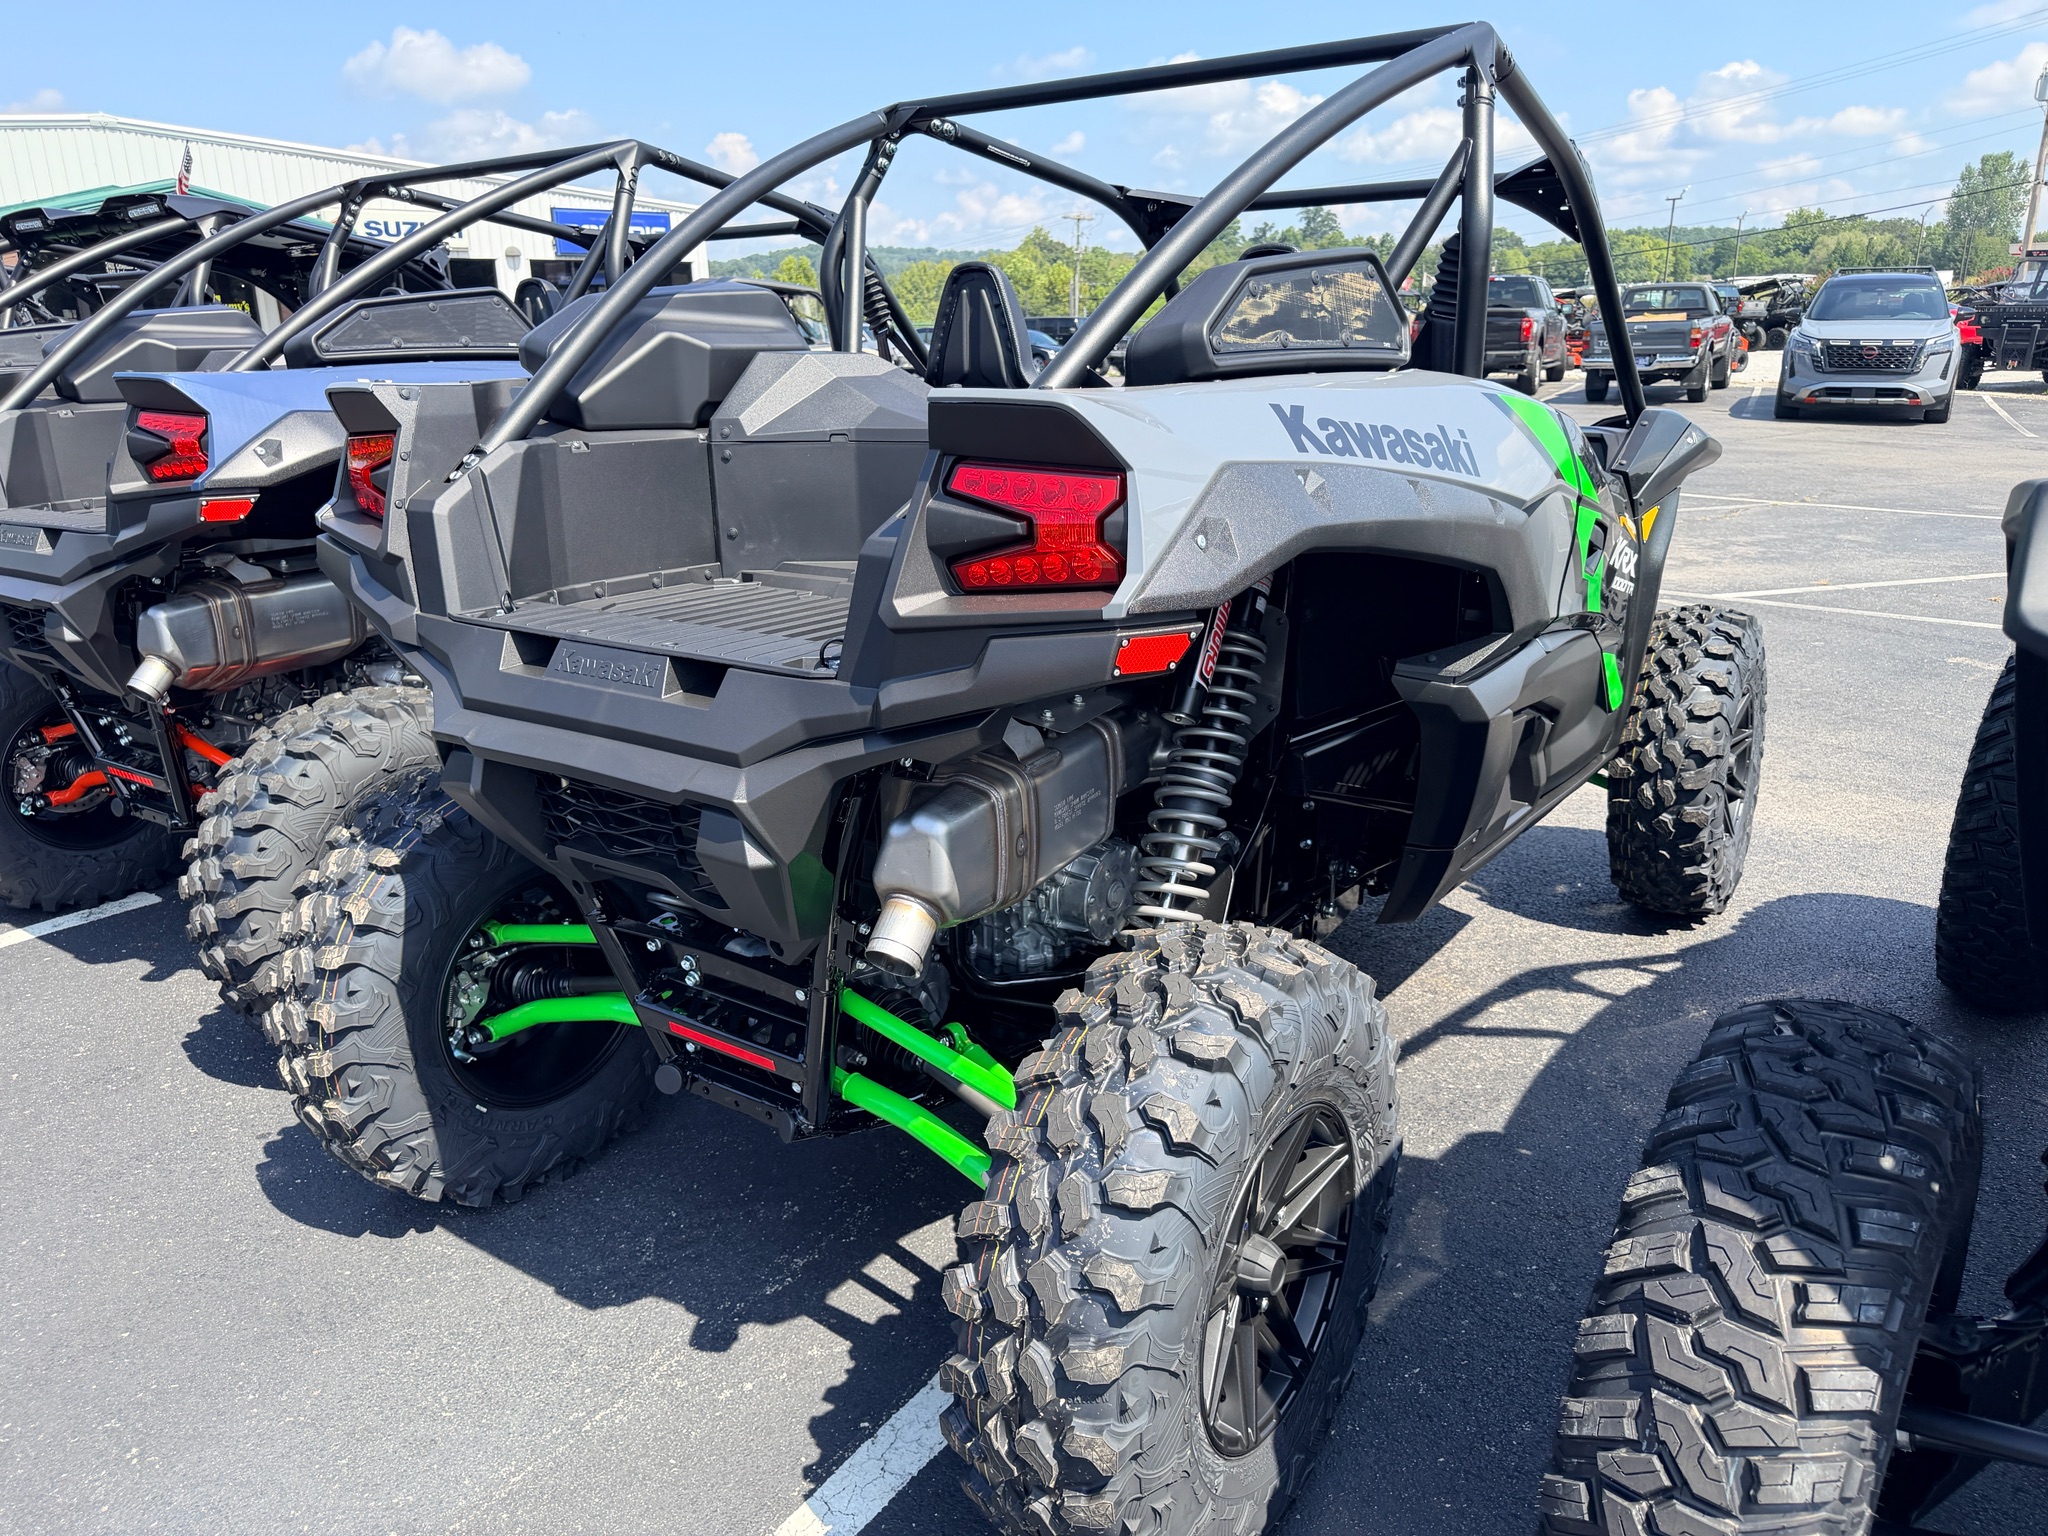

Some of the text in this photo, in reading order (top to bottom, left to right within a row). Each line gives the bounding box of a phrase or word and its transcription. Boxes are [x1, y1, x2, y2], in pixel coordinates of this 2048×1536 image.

[1268, 403, 1481, 477] Kawasaki
[1610, 536, 1638, 578] KRX
[555, 648, 660, 688] Kawasaki
[1202, 600, 1232, 679] SHOWA
